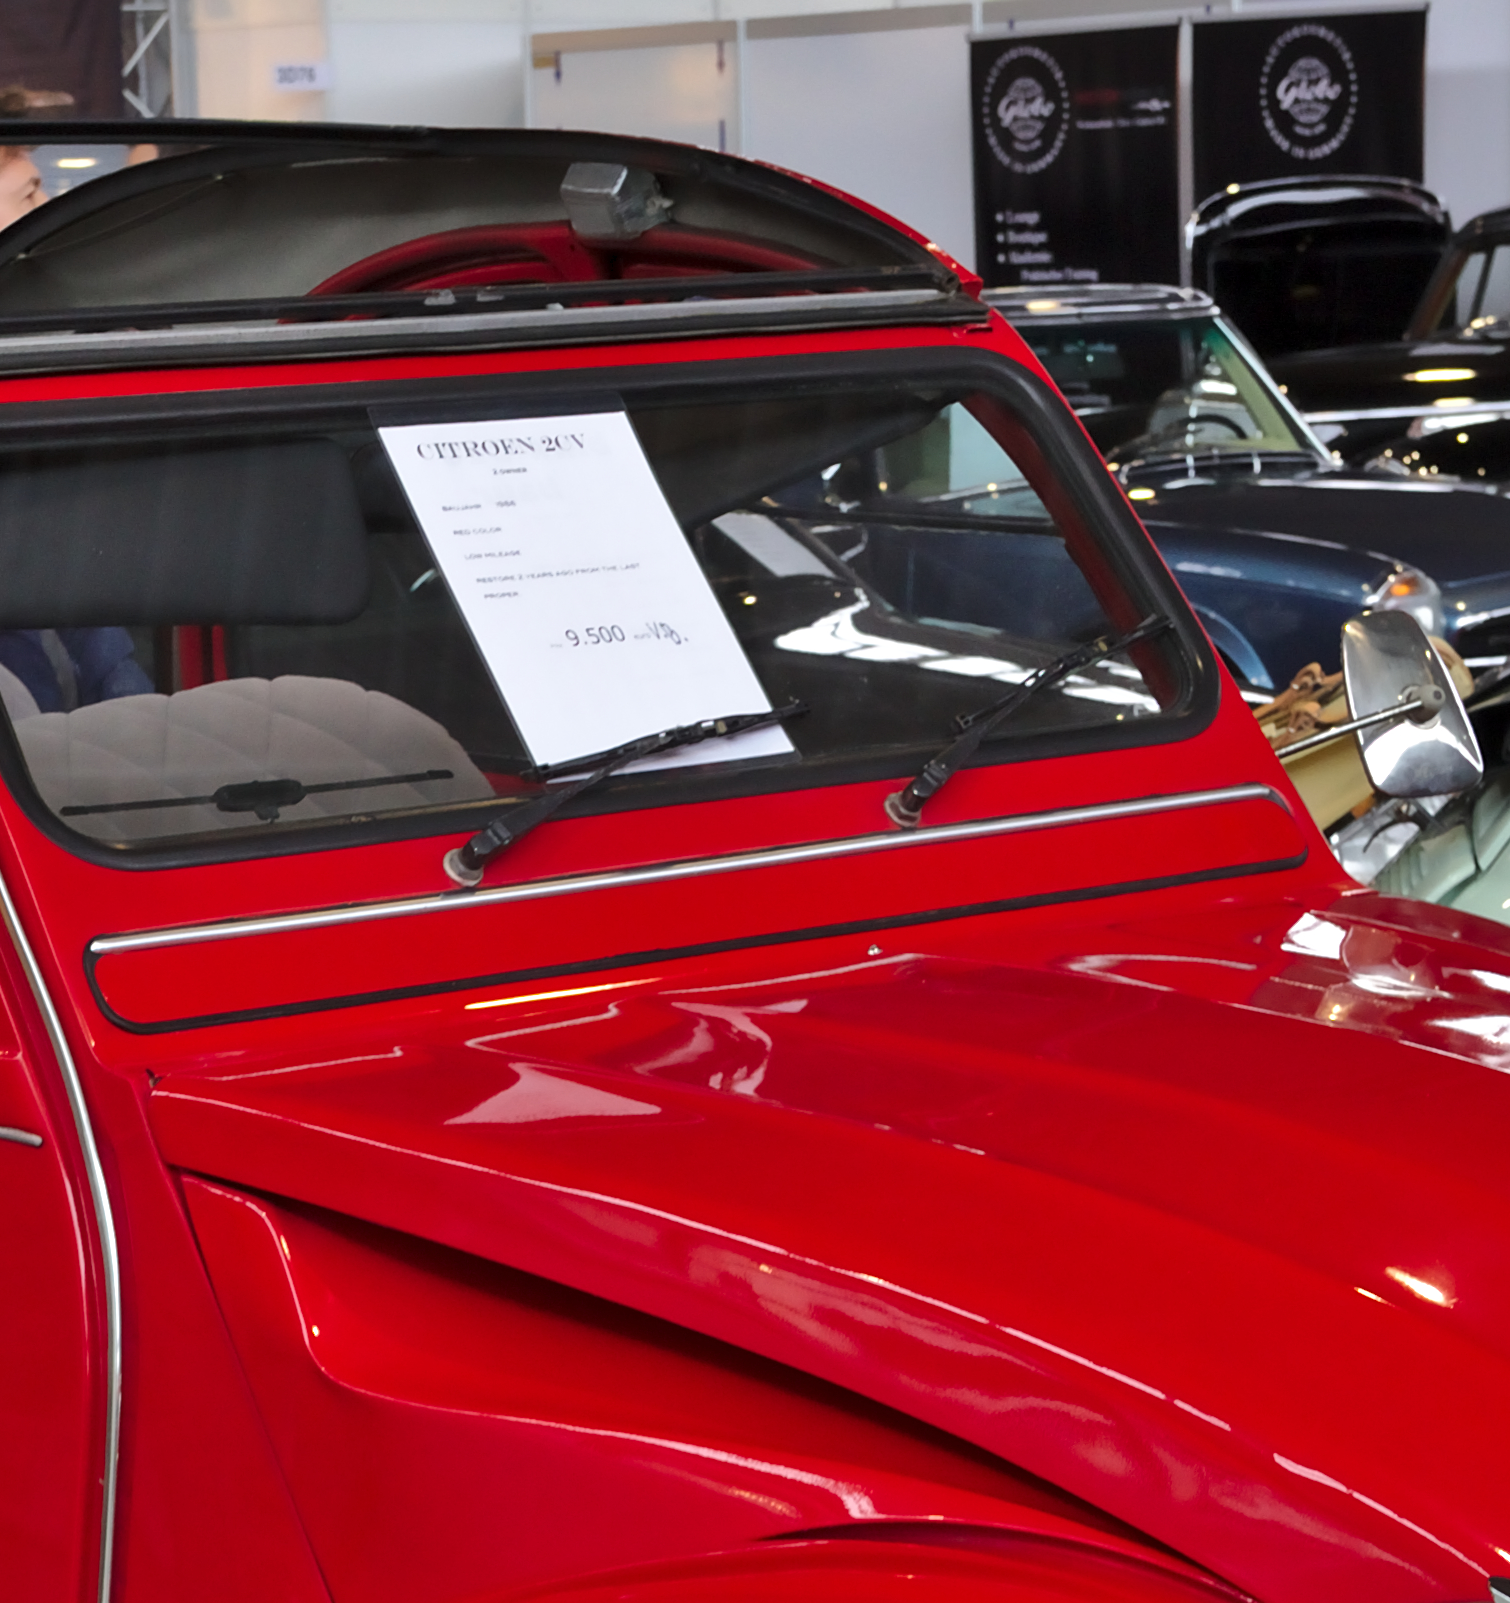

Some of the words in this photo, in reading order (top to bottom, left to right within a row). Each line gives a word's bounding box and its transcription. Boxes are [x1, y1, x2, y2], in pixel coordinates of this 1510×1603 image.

[416, 436, 536, 460] CITROEN
[541, 433, 585, 452] 2CV
[565, 624, 626, 647] 9.500
